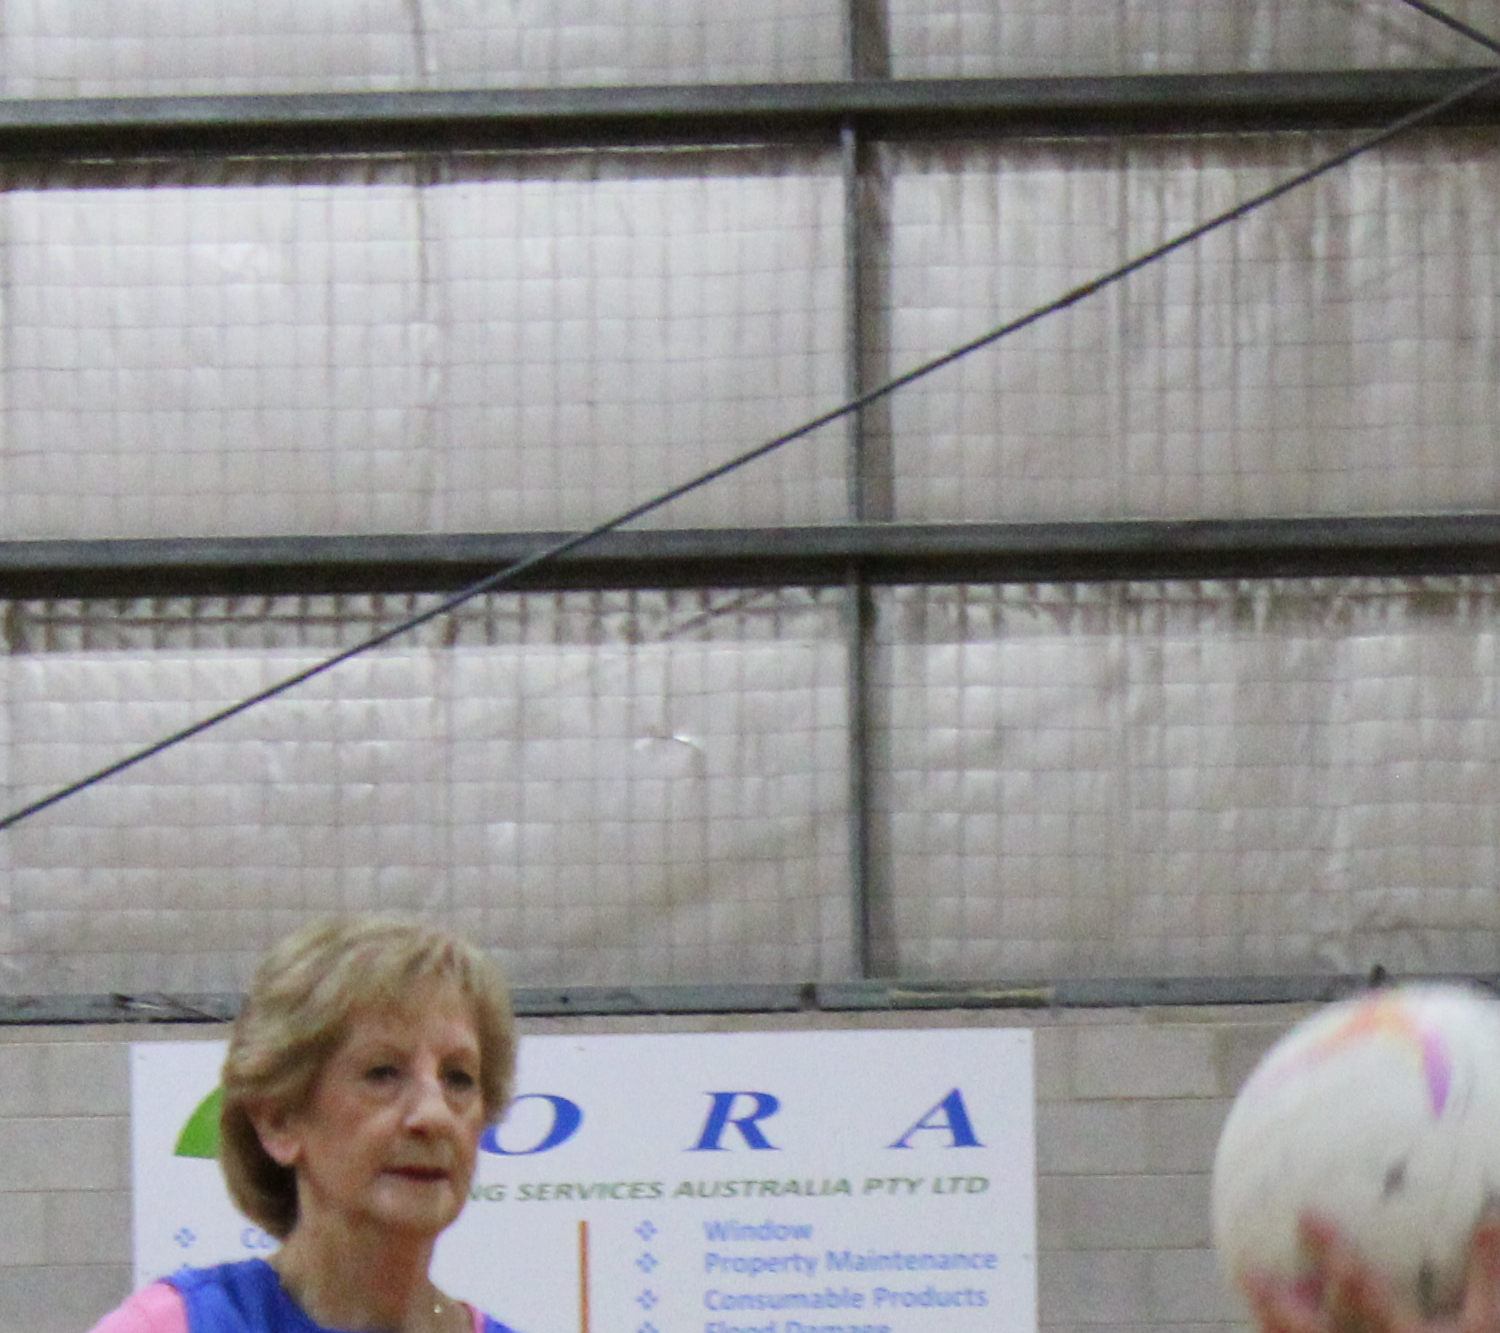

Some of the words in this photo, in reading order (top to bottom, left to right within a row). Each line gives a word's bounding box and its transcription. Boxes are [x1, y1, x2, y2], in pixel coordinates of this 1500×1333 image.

[514, 1182, 664, 1201] SERVICES
[673, 1177, 853, 1200] AUSTRALIA
[863, 1176, 924, 1196] PTY
[932, 1175, 990, 1195] LTD
[703, 1220, 813, 1241] Window
[705, 1252, 818, 1277] Property
[825, 1249, 998, 1272] Maintenance
[704, 1288, 865, 1311] Consumable
[872, 1286, 989, 1308] Products
